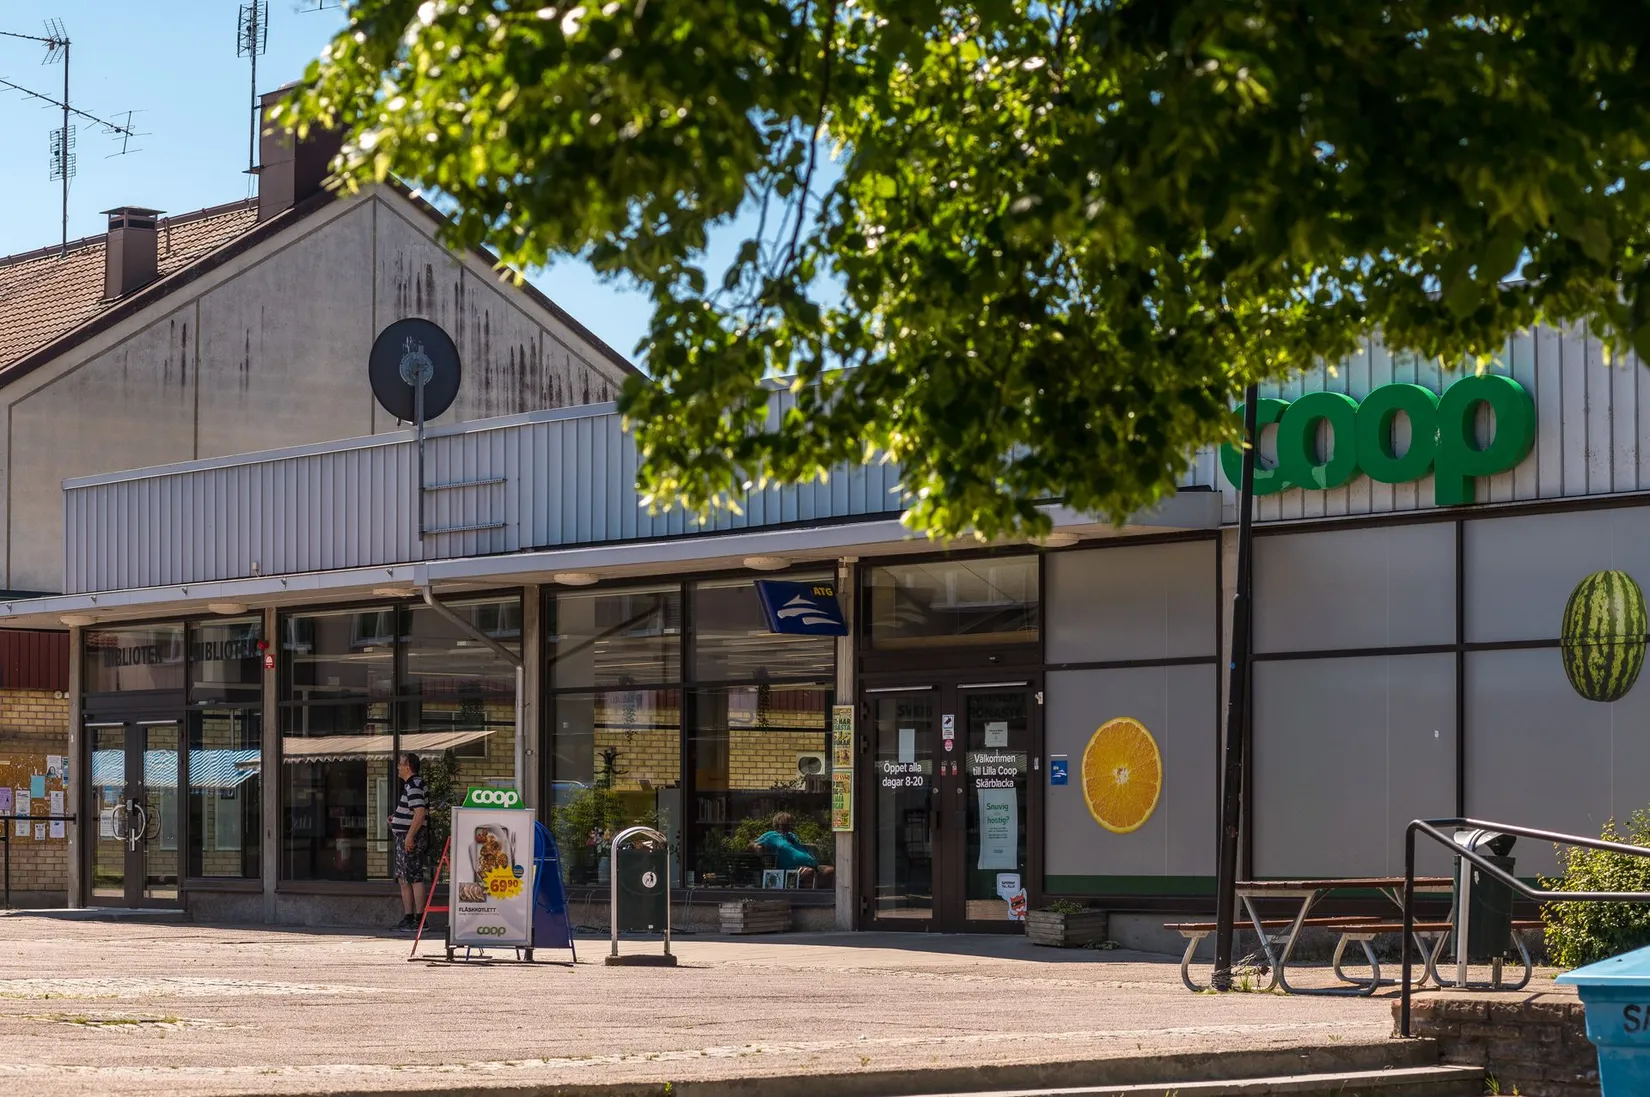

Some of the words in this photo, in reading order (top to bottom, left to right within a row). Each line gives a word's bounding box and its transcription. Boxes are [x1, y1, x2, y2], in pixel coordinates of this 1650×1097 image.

[1221, 374, 1535, 505] coop
[813, 587, 833, 596] ATG
[974, 754, 1016, 764] Välkommen
[884, 762, 907, 775] Öppet
[908, 763, 922, 773] alla
[972, 767, 981, 776] till
[982, 766, 997, 776] Lilla
[998, 766, 1018, 778] Coop
[882, 777, 905, 789] dagar
[905, 776, 924, 787] 8-20
[975, 778, 1014, 788] Skärblacka
[471, 789, 518, 808] coop
[986, 803, 1009, 812] Snuvig
[987, 816, 1010, 826] hostig?
[476, 926, 506, 937] coop
